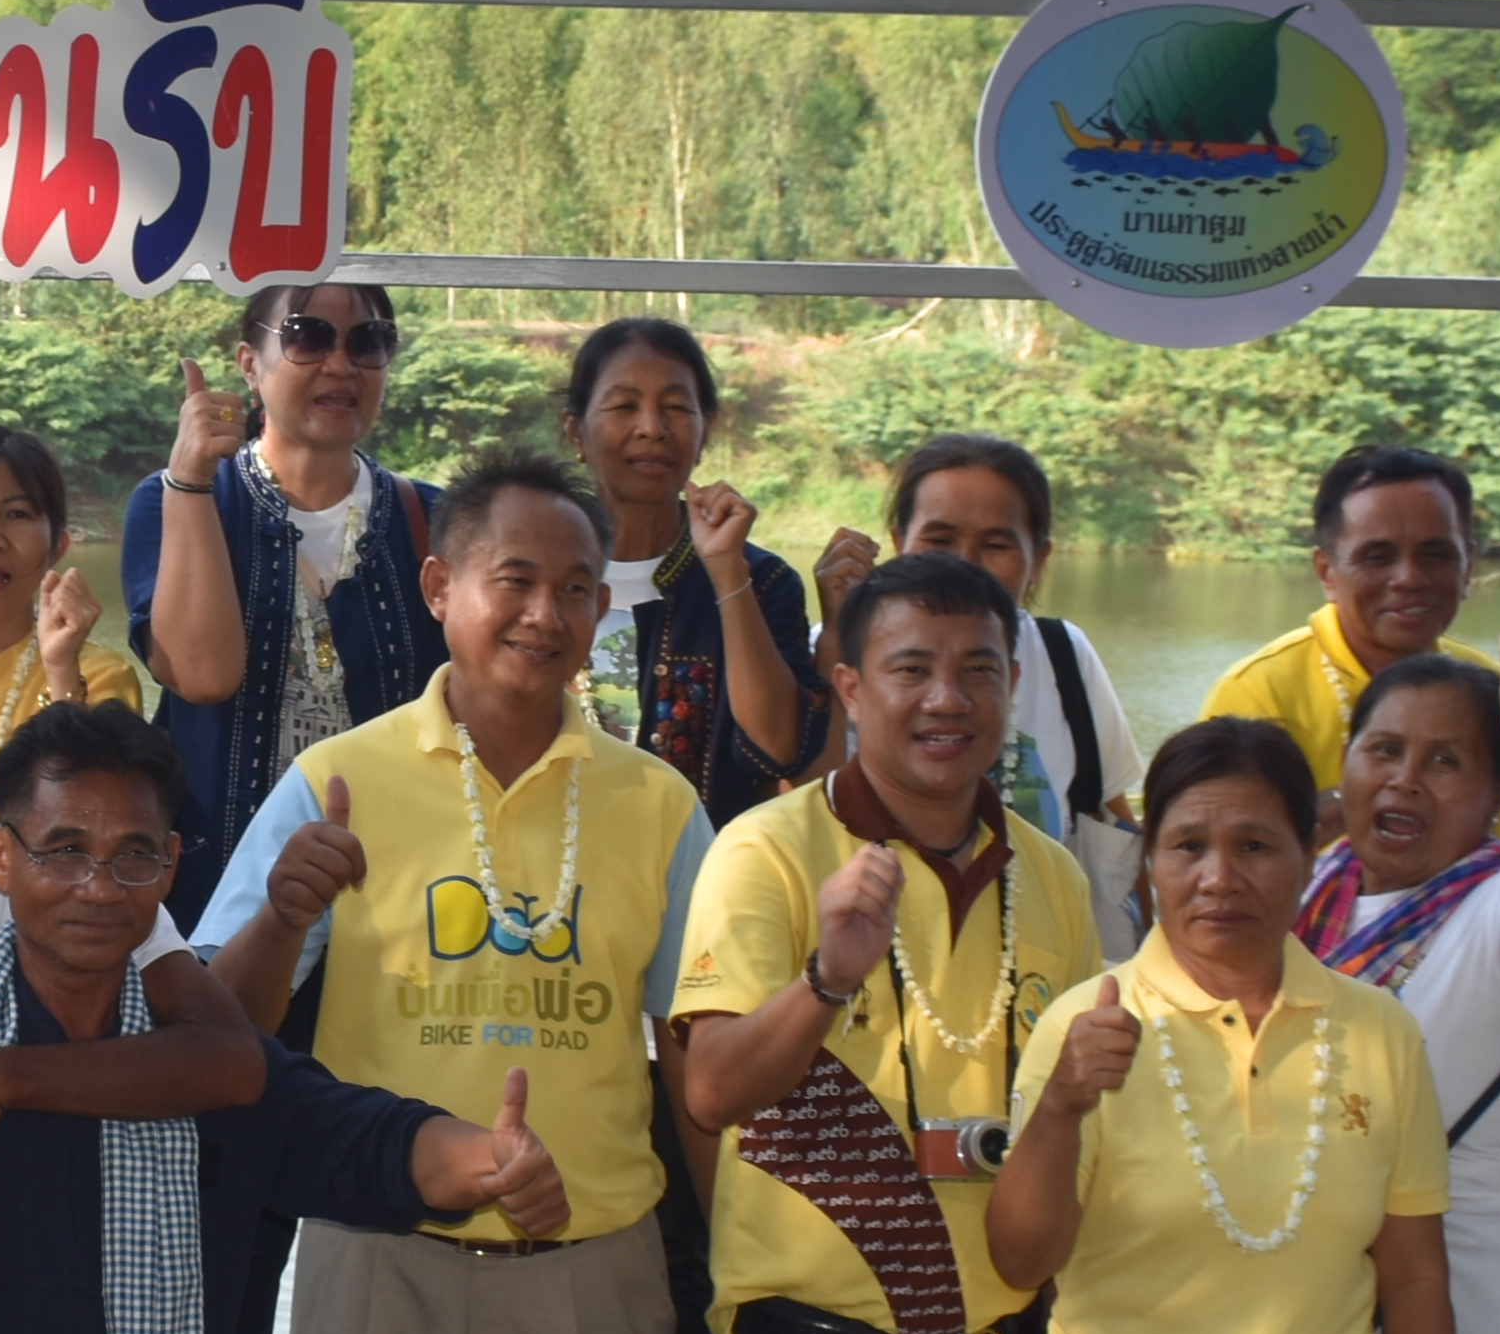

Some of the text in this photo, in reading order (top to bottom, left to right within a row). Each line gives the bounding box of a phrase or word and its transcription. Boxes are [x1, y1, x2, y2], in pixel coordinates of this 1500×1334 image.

[1123, 199, 1246, 243] บ้านท่าตูม
[420, 1023, 589, 1050] BIKE FOR DAD
